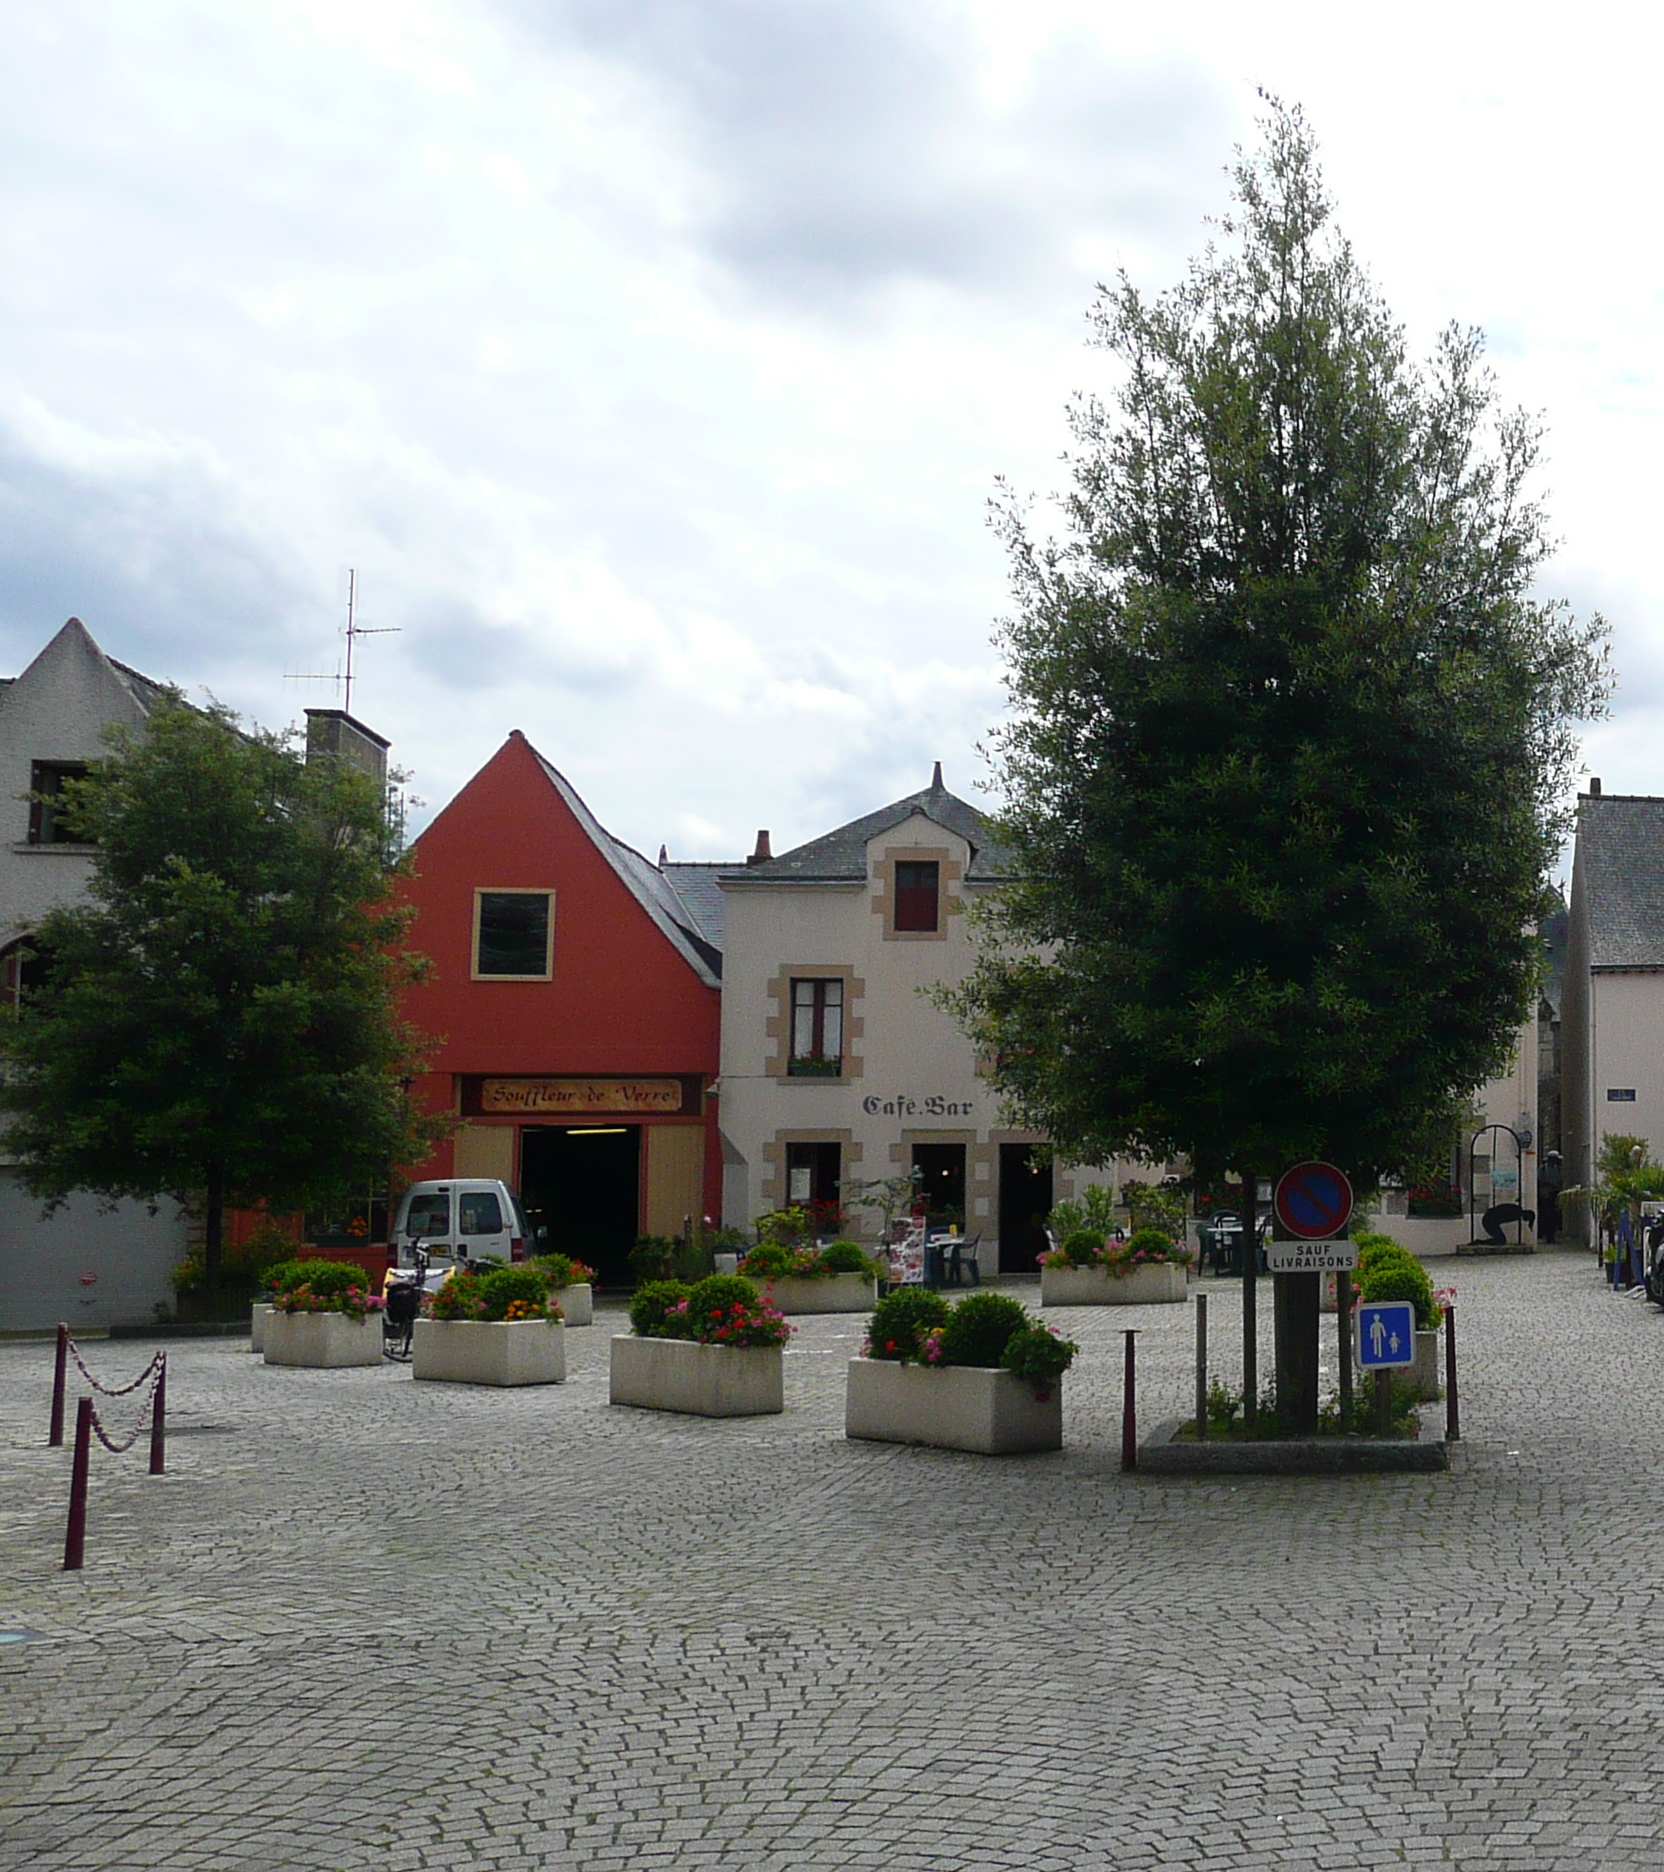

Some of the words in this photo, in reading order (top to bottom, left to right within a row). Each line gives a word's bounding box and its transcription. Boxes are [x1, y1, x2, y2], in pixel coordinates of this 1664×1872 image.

[493, 1085, 576, 1107] Souffleur
[588, 1085, 605, 1102] de
[615, 1086, 671, 1102] Verre
[1296, 1245, 1332, 1256] SAUF
[1272, 1256, 1354, 1268] LIVRAISONS
